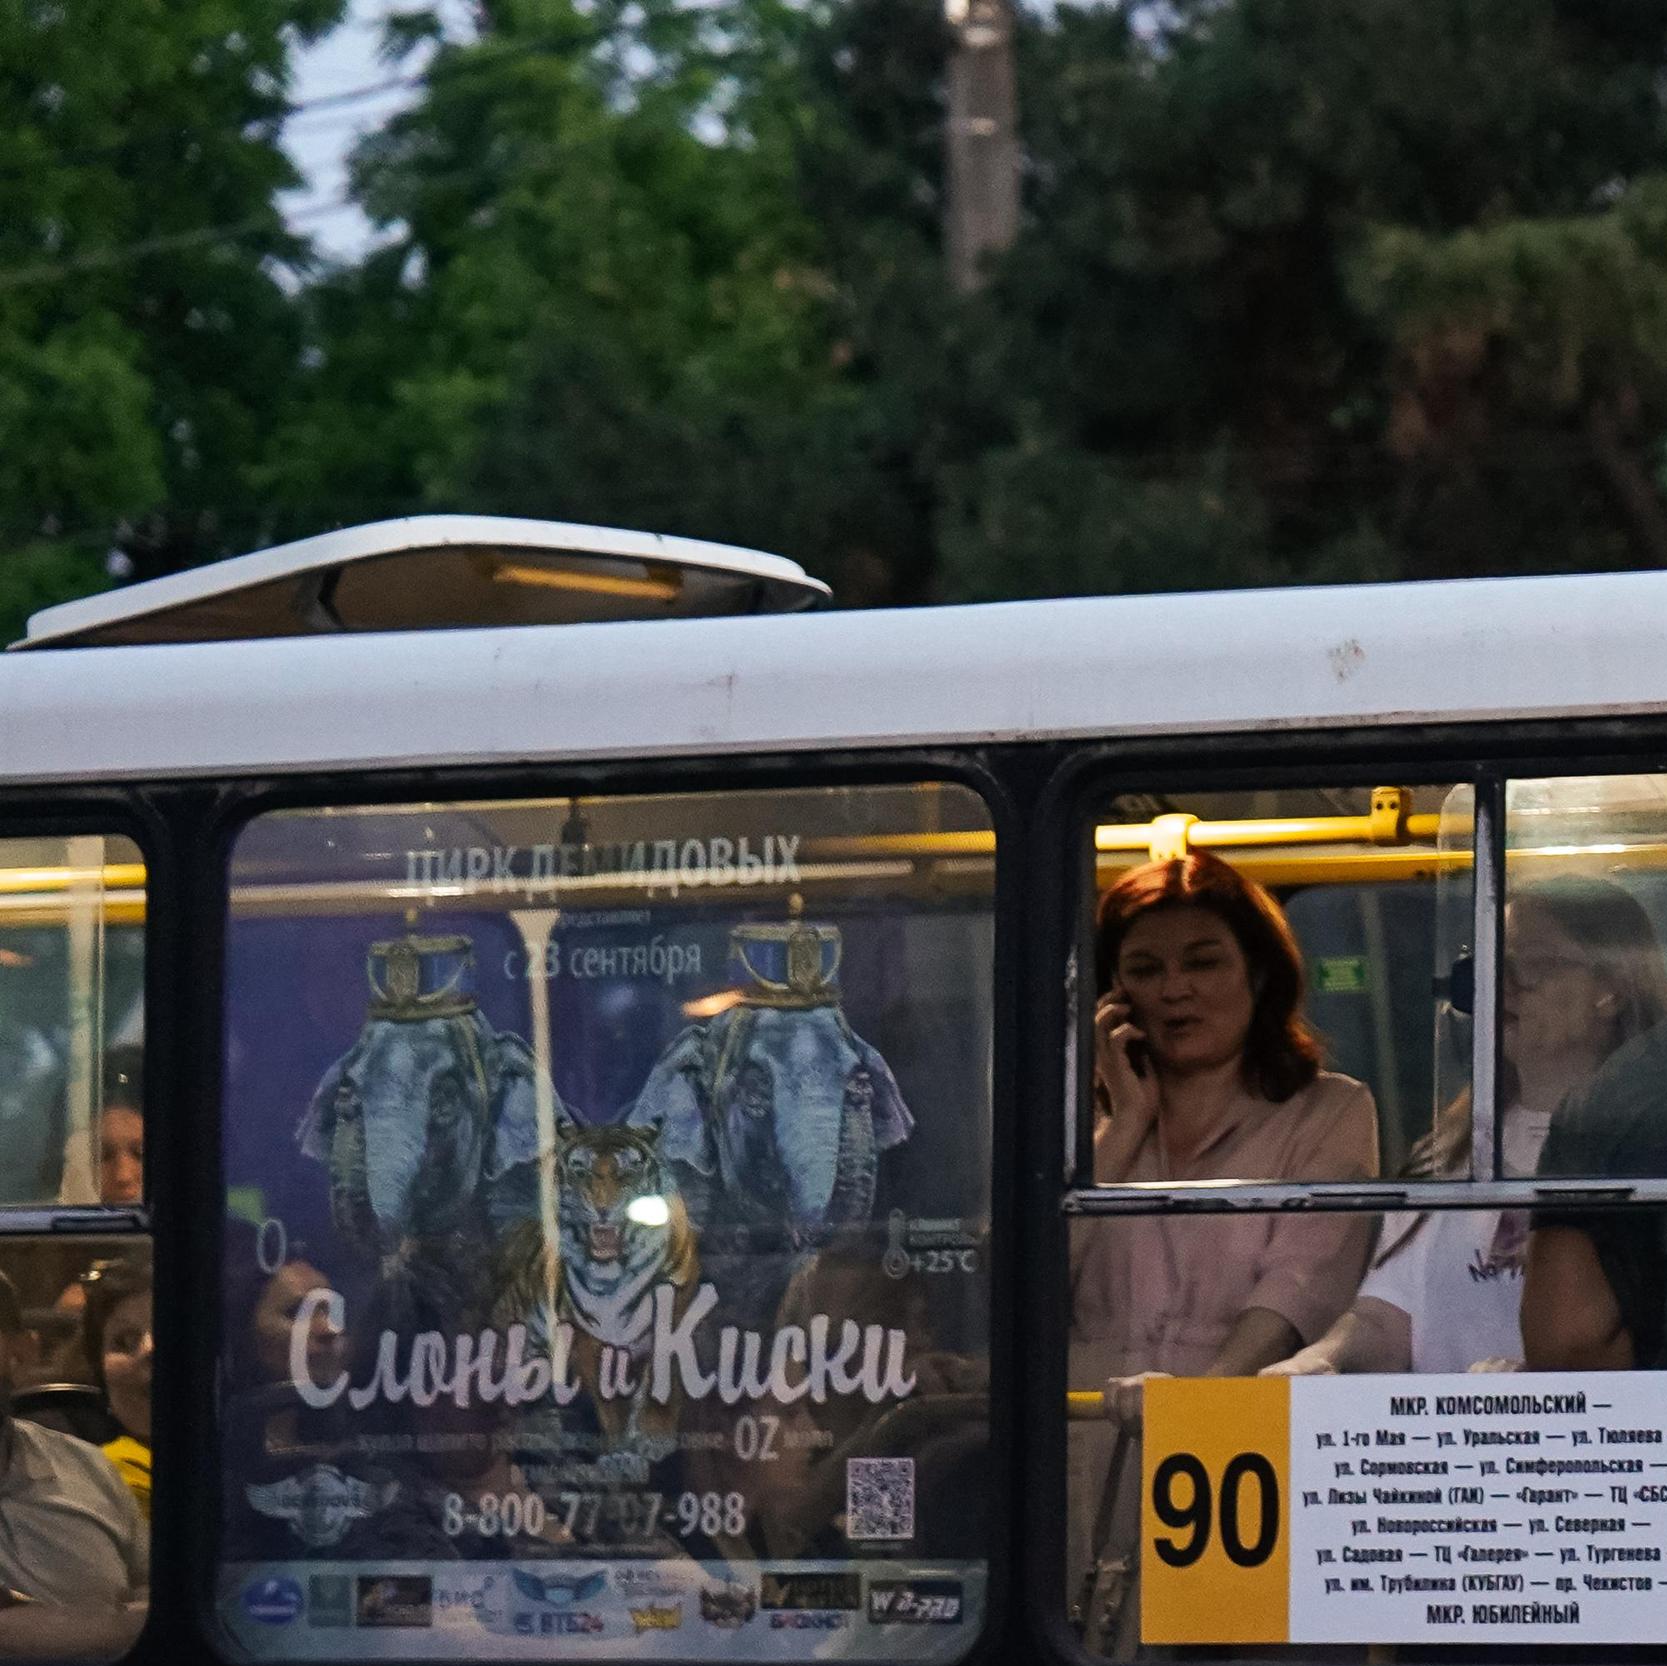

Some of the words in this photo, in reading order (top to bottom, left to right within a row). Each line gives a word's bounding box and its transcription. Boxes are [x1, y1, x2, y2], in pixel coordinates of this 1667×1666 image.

[570, 931, 701, 984] сентября
[289, 1287, 580, 1411] Слоны
[599, 1343, 637, 1400] и
[651, 1283, 918, 1404] Киски
[1389, 1396, 1430, 1417] МКР.
[1435, 1390, 1587, 1416] КОМСОМОЛЬСКИЙ
[1315, 1432, 1337, 1450] ул.
[1342, 1429, 1371, 1448] 1-го
[1375, 1429, 1407, 1447] Мая
[1435, 1431, 1458, 1449] ул.
[1462, 1428, 1541, 1449] Уральская
[1571, 1429, 1593, 1448] ул.
[1333, 1461, 1356, 1480] ул.
[1359, 1458, 1449, 1479] Сормовская
[1479, 1460, 1501, 1478] ул.
[1505, 1456, 1644, 1477] Симферопольская
[1301, 1490, 1324, 1509] ул.
[1609, 1485, 1629, 1506] ТЦ
[1151, 1451, 1281, 1568] 90
[1350, 1519, 1372, 1537] ул.
[1376, 1516, 1498, 1537] Новороссийская
[1528, 1518, 1550, 1536] ул.
[1554, 1515, 1626, 1535] Северная
[1315, 1548, 1338, 1567] ул.
[1341, 1545, 1404, 1565] Садовая
[1433, 1545, 1453, 1565] ТЦ
[1559, 1547, 1582, 1566] ул.
[1585, 1544, 1662, 1565] Тургенева
[1324, 1577, 1346, 1596] ул.
[1554, 1576, 1578, 1594] пр.
[1426, 1603, 1466, 1625] МКР.
[1471, 1600, 1581, 1625] ЮБИЛЕЙНЫЙ
